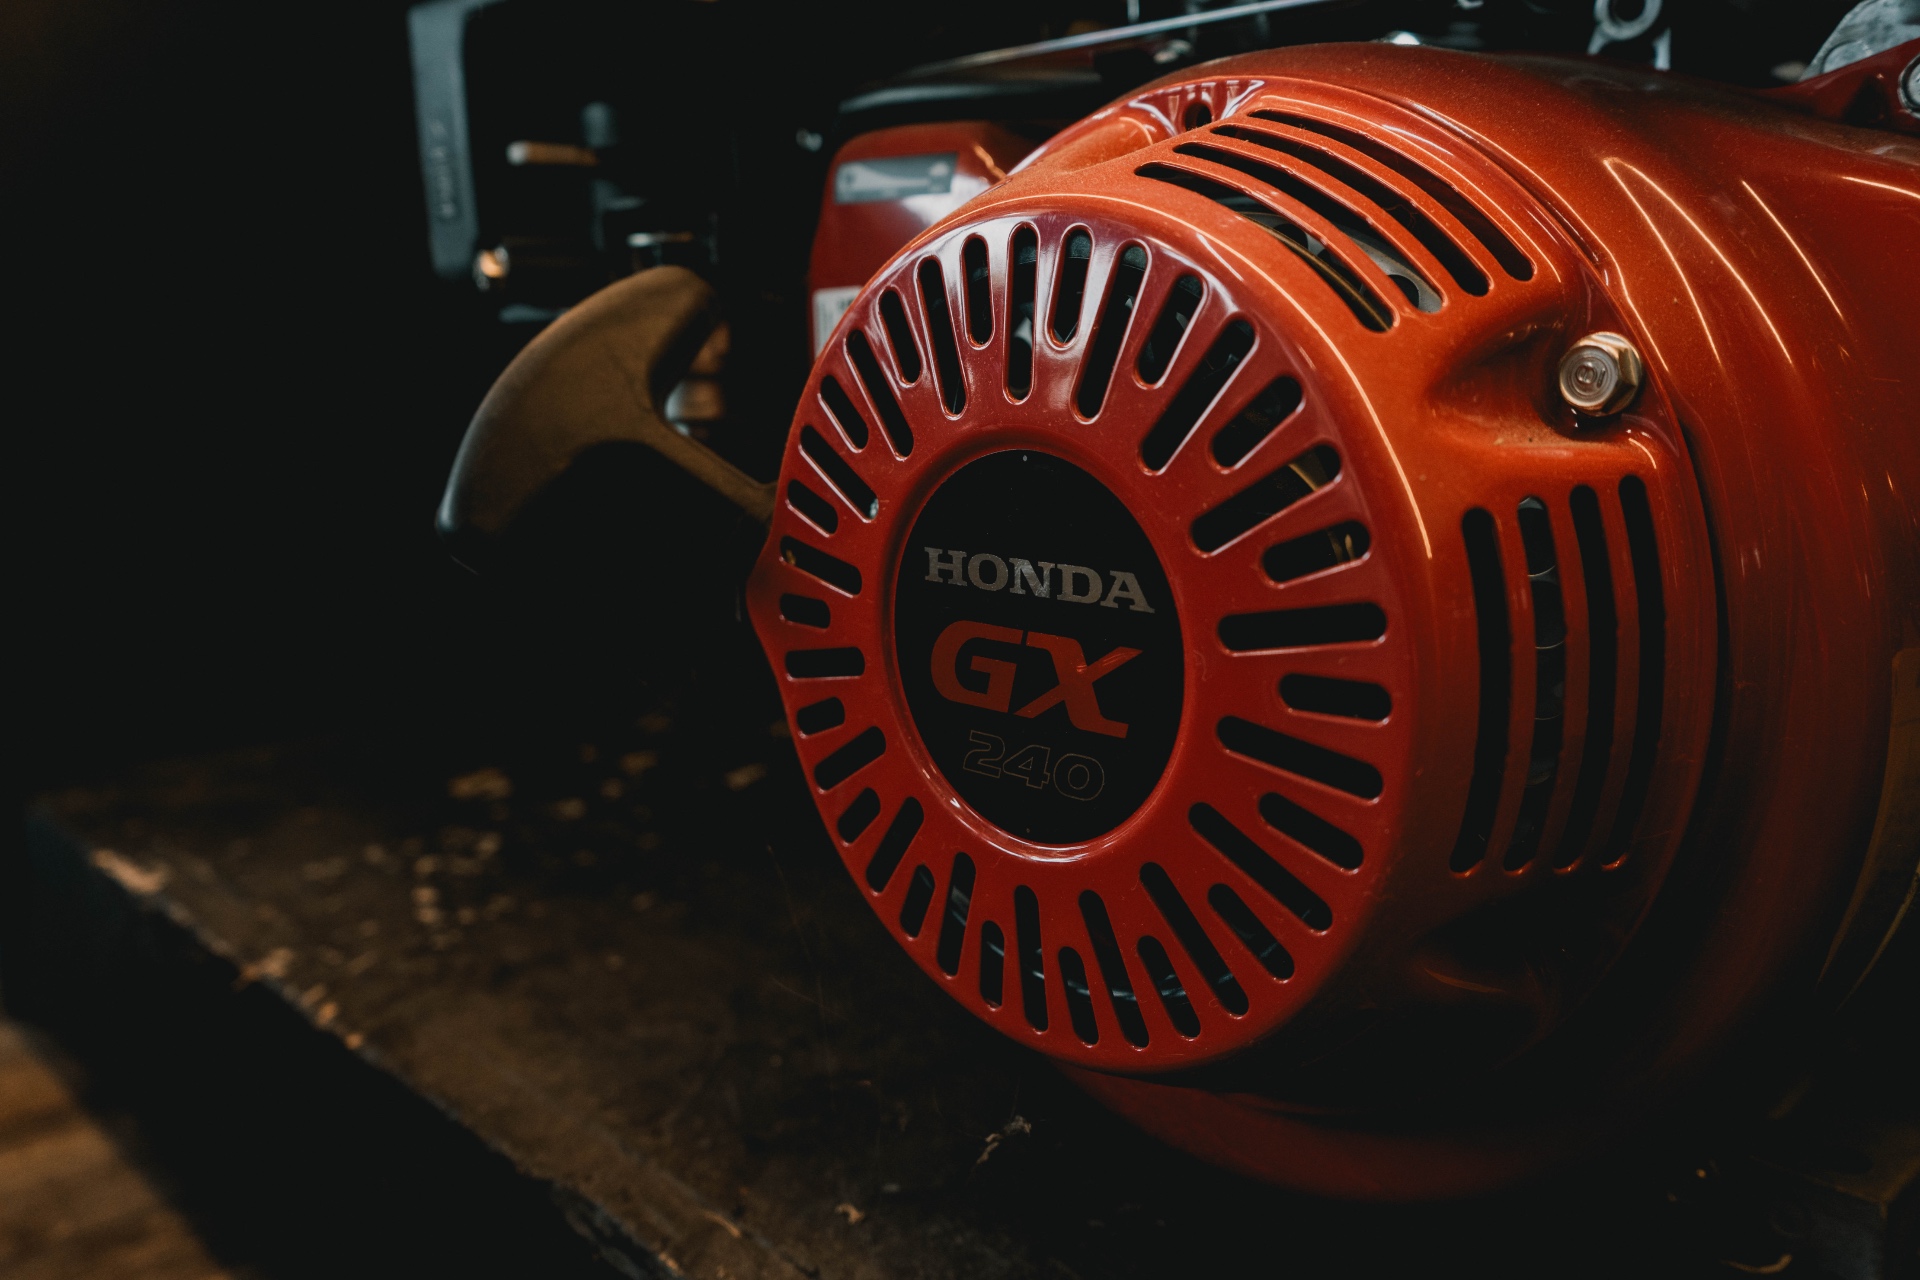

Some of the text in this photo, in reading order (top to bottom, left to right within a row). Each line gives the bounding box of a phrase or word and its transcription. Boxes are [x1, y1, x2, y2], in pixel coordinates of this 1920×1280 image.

[924, 546, 1156, 614] HONDA
[930, 619, 1144, 739] GX
[963, 729, 1105, 801] 240
